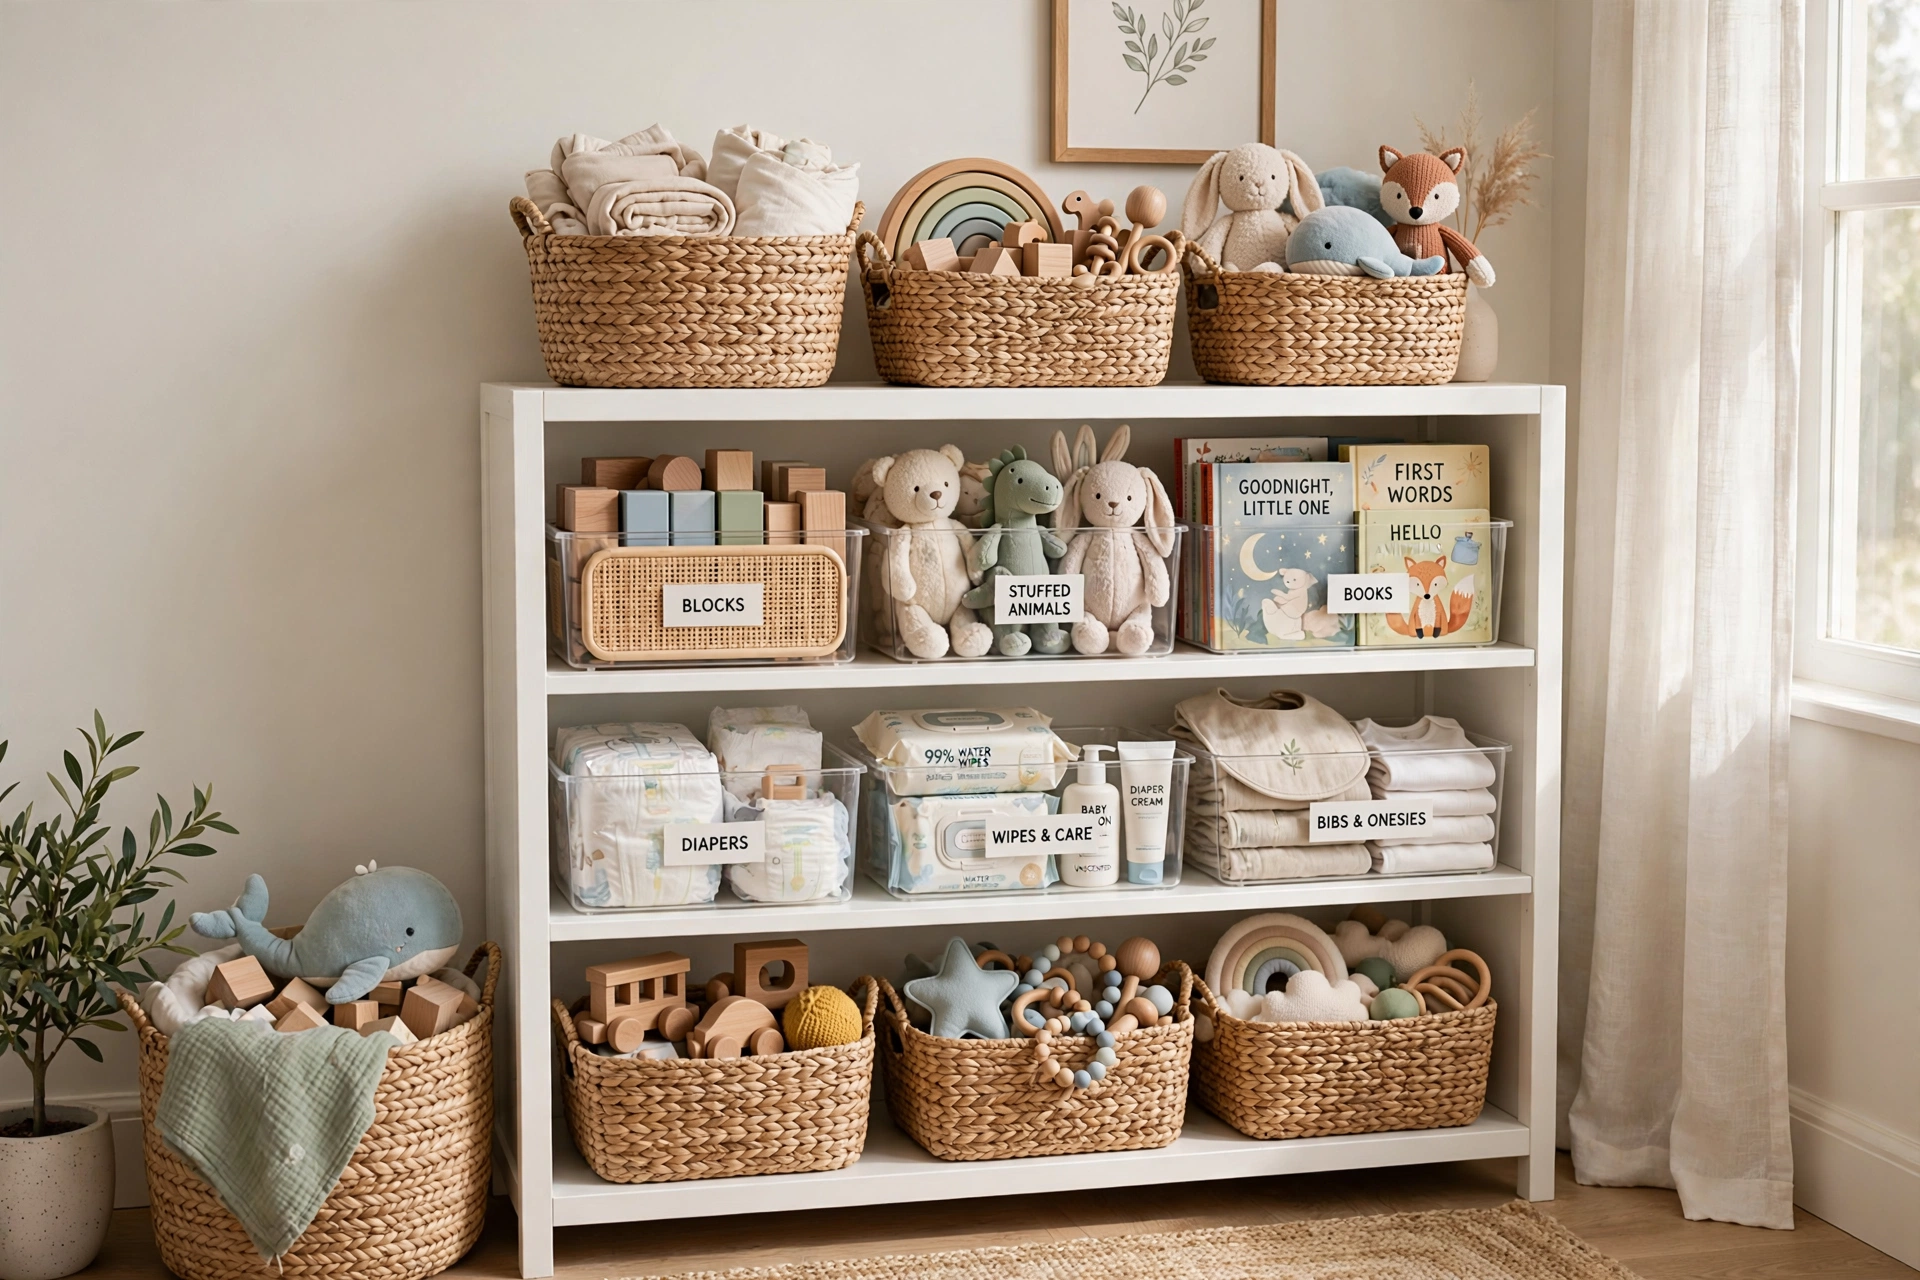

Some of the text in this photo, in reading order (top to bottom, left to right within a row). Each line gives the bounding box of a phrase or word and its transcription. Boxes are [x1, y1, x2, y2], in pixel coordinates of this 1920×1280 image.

[1395, 462, 1445, 481] FIRST
[1238, 478, 1334, 497] GOODNIGHT,
[1387, 485, 1453, 503] WORDS
[1243, 499, 1330, 516] LITTLE ONE
[1390, 524, 1442, 541] HELLO
[1008, 583, 1071, 598] STUFFED
[1344, 586, 1393, 601] BOOKS
[682, 597, 745, 613] BLOCKS
[1008, 601, 1071, 617] ANIMALS
[924, 748, 955, 764] 99%
[958, 746, 992, 757] WATER
[958, 758, 989, 768] WIPES
[1130, 784, 1164, 794] DIAPER
[1081, 804, 1107, 815] BABY
[1130, 797, 1163, 807] CREAM
[1317, 811, 1427, 830] BIBS & ONESIES
[992, 828, 1037, 844] WIPES
[1040, 828, 1051, 843] &
[1054, 826, 1093, 842] CARE
[682, 835, 749, 852] DIAPERS
